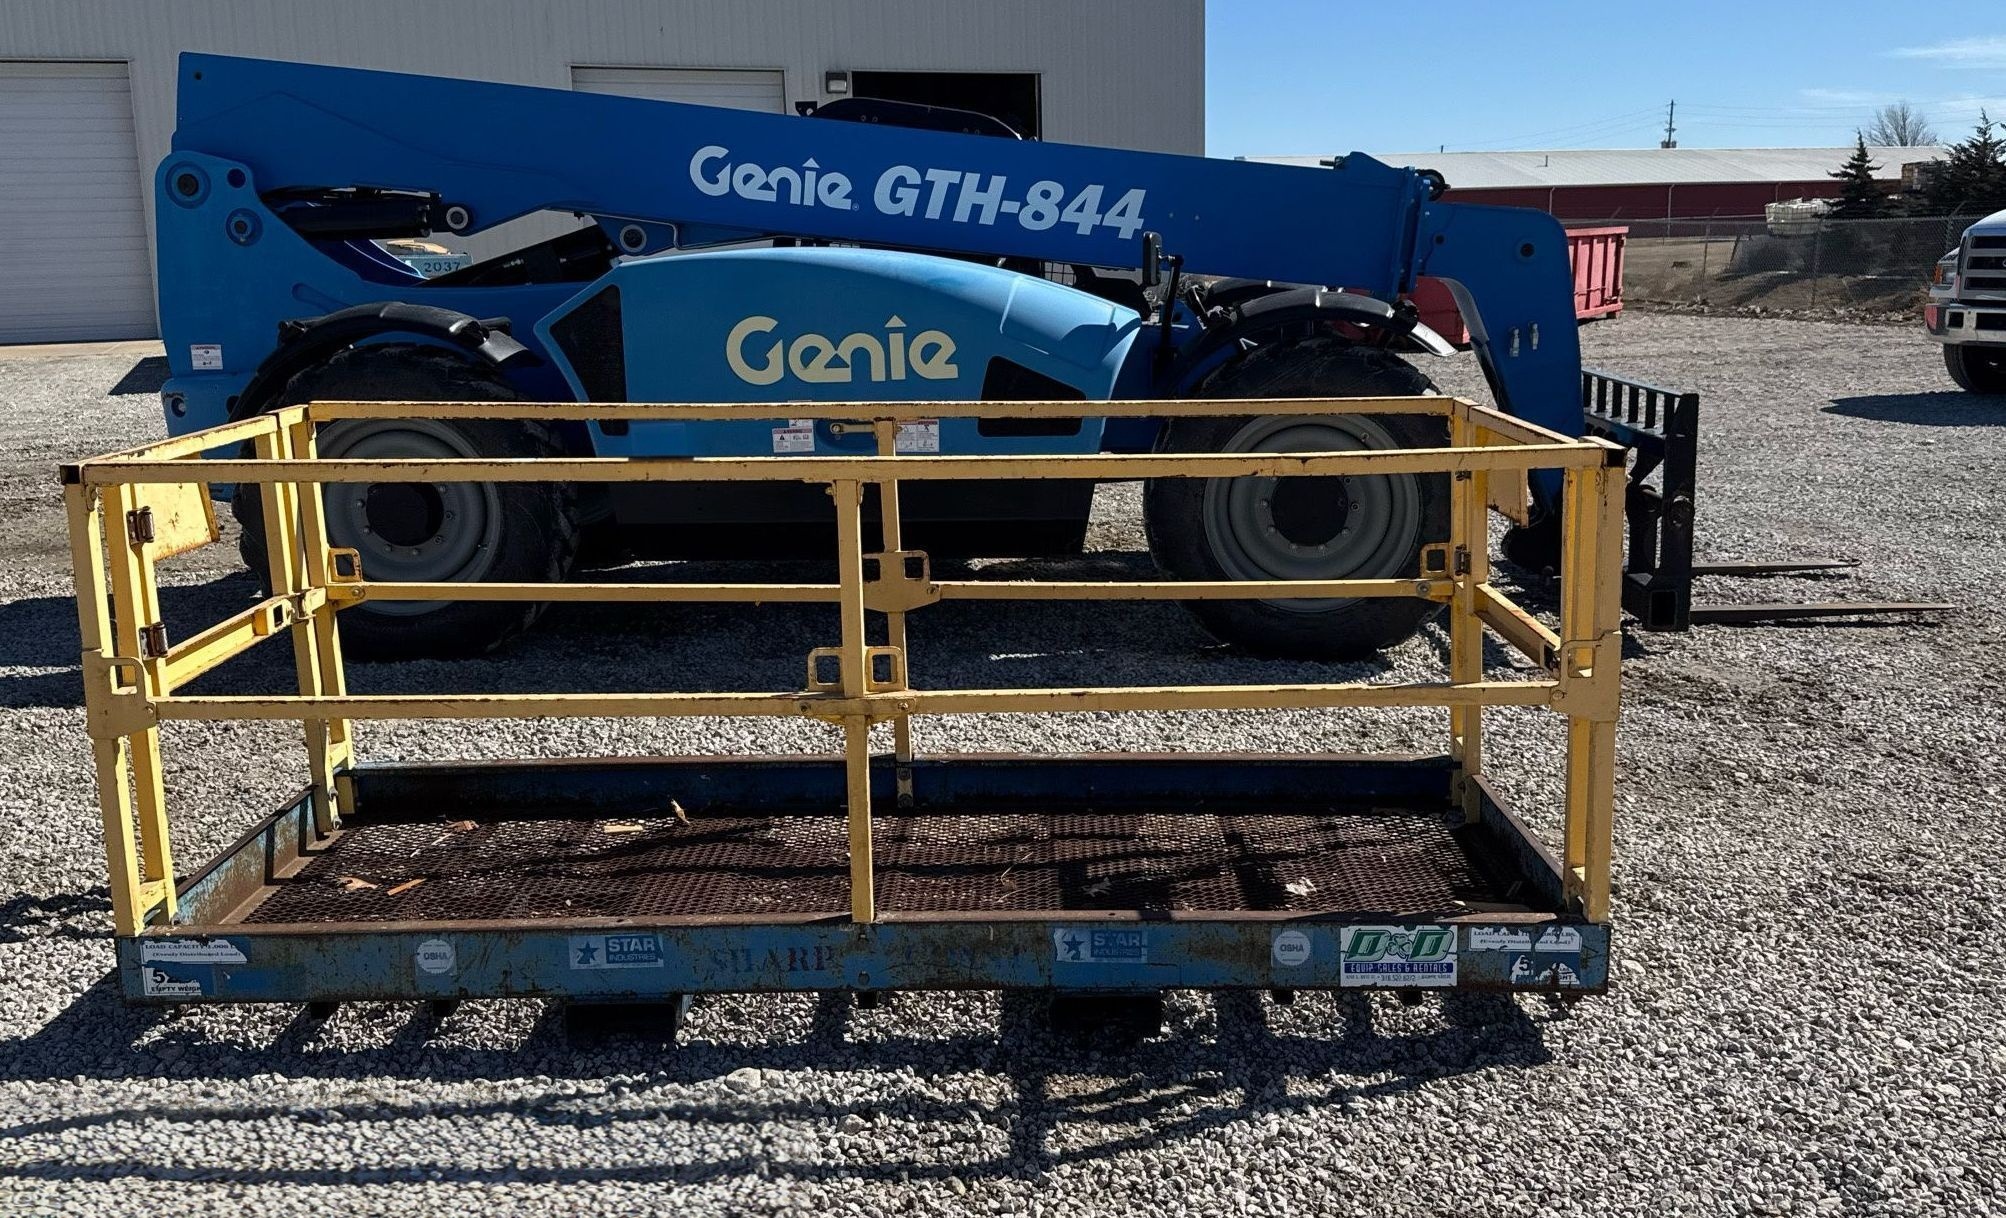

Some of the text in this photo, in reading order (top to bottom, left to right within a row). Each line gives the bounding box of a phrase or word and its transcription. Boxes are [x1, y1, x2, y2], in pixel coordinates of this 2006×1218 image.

[689, 145, 1147, 240] Genie GTH-844
[423, 261, 461, 273] 2037
[726, 314, 959, 385] Genie
[608, 938, 655, 952] STAR
[1280, 943, 1304, 952] OSHA
[423, 952, 450, 960] OSHA
[608, 953, 656, 962] INDUSTRIES
[1378, 964, 1402, 972] SALES
[1413, 964, 1448, 972] RENTALS
